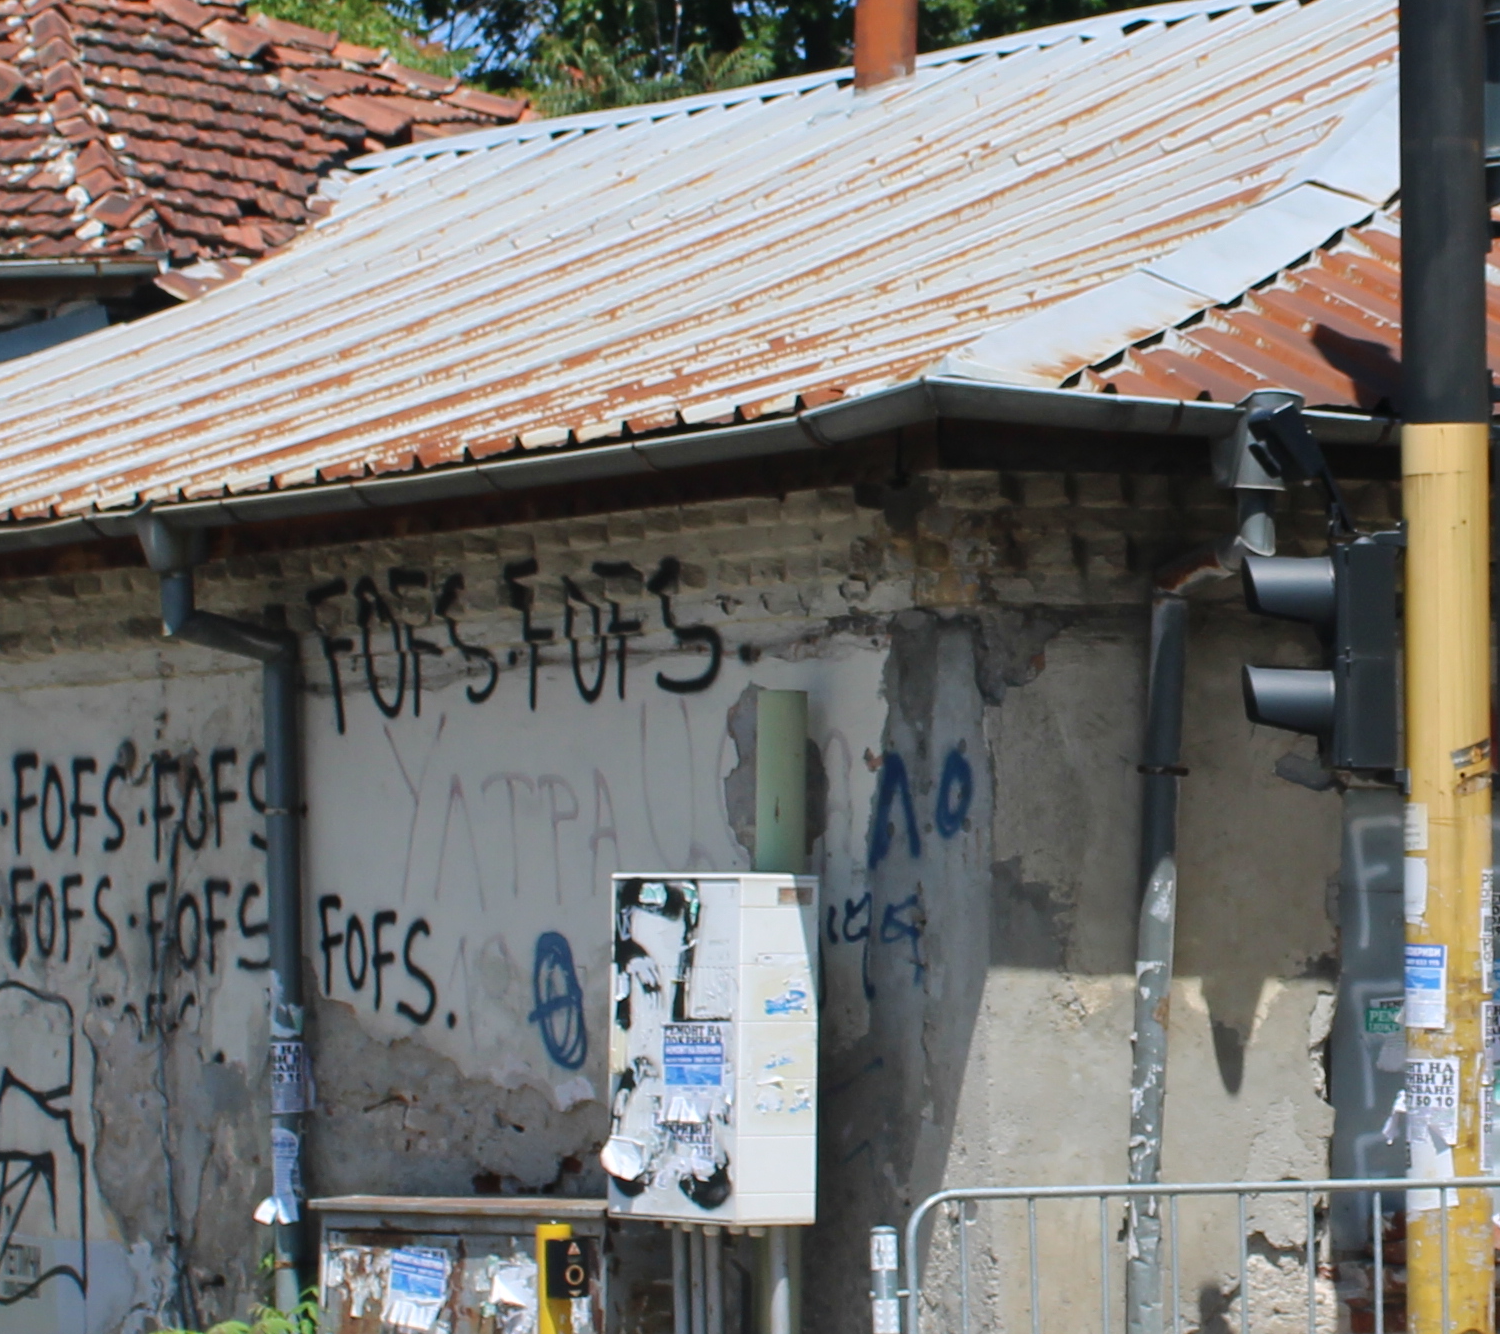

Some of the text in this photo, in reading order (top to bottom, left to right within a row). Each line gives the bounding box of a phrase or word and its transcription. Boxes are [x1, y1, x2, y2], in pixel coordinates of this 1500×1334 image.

[1428, 1061, 1454, 1074] НА
[1416, 1095, 1431, 1107] 50
[1434, 1095, 1454, 1107] 10
